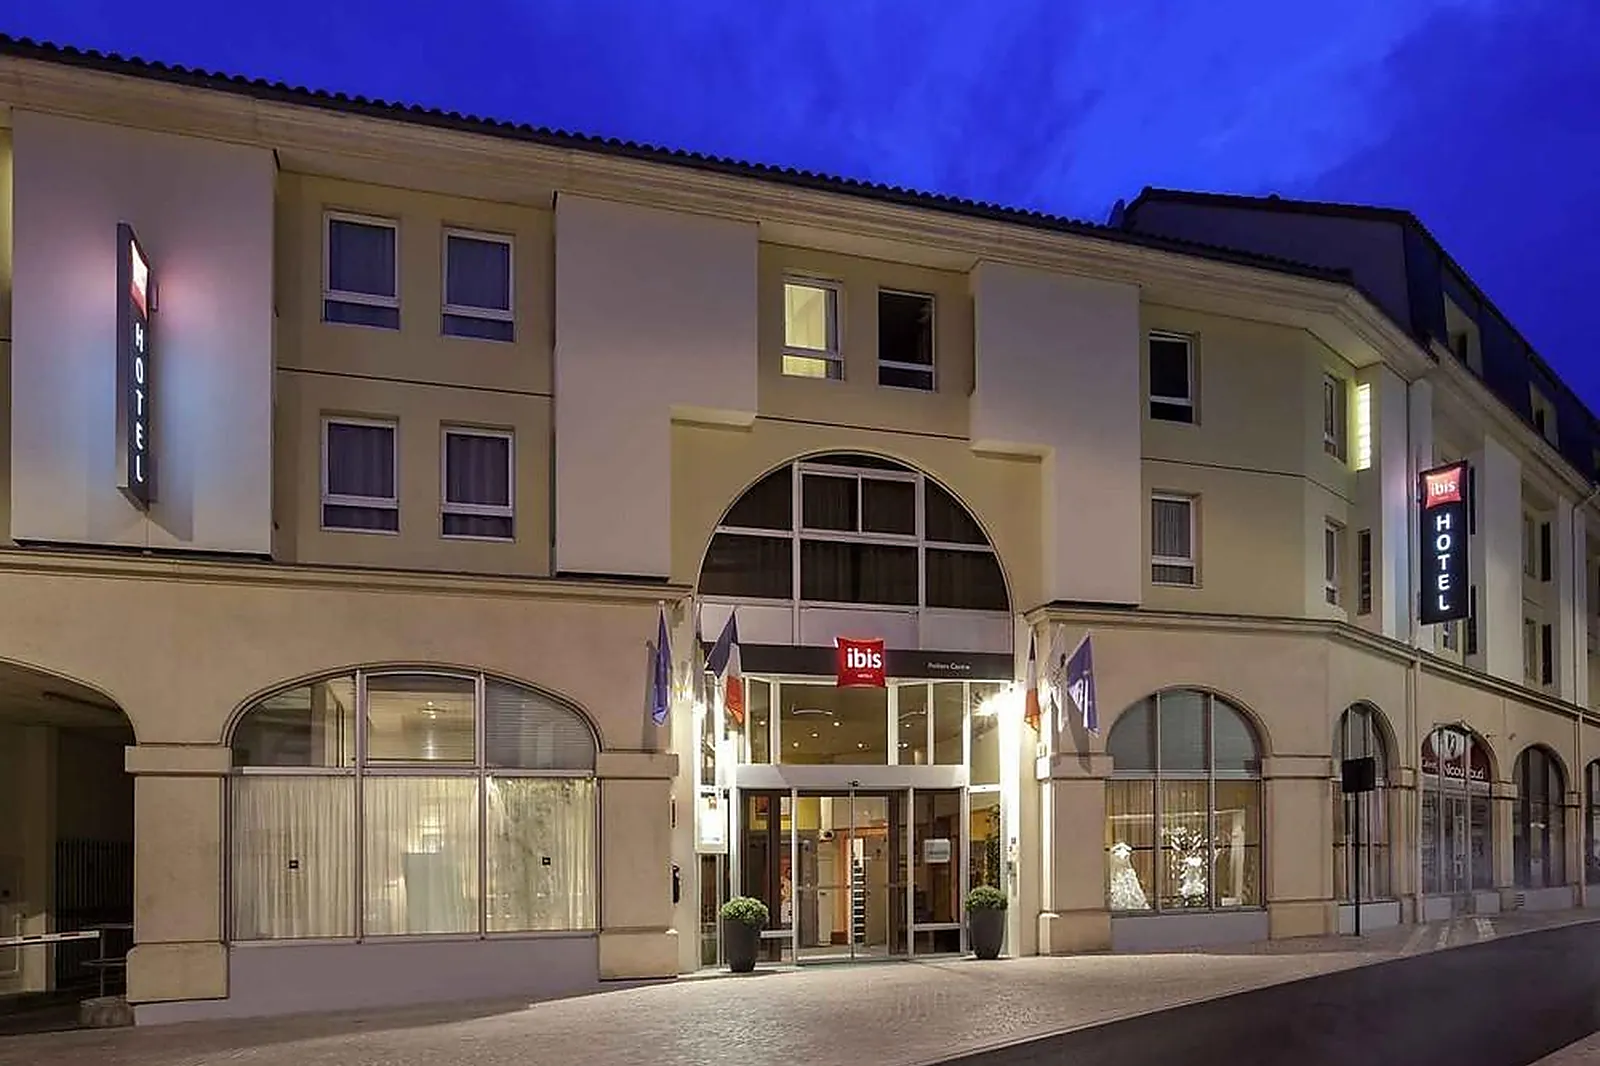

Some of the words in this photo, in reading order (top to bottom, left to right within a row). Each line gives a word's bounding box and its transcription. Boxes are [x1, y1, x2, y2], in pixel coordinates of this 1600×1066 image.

[134, 322, 144, 483] HOTEL
[1431, 480, 1457, 497] ibis
[1436, 513, 1452, 612] HOTEL
[847, 647, 882, 669] ibis
